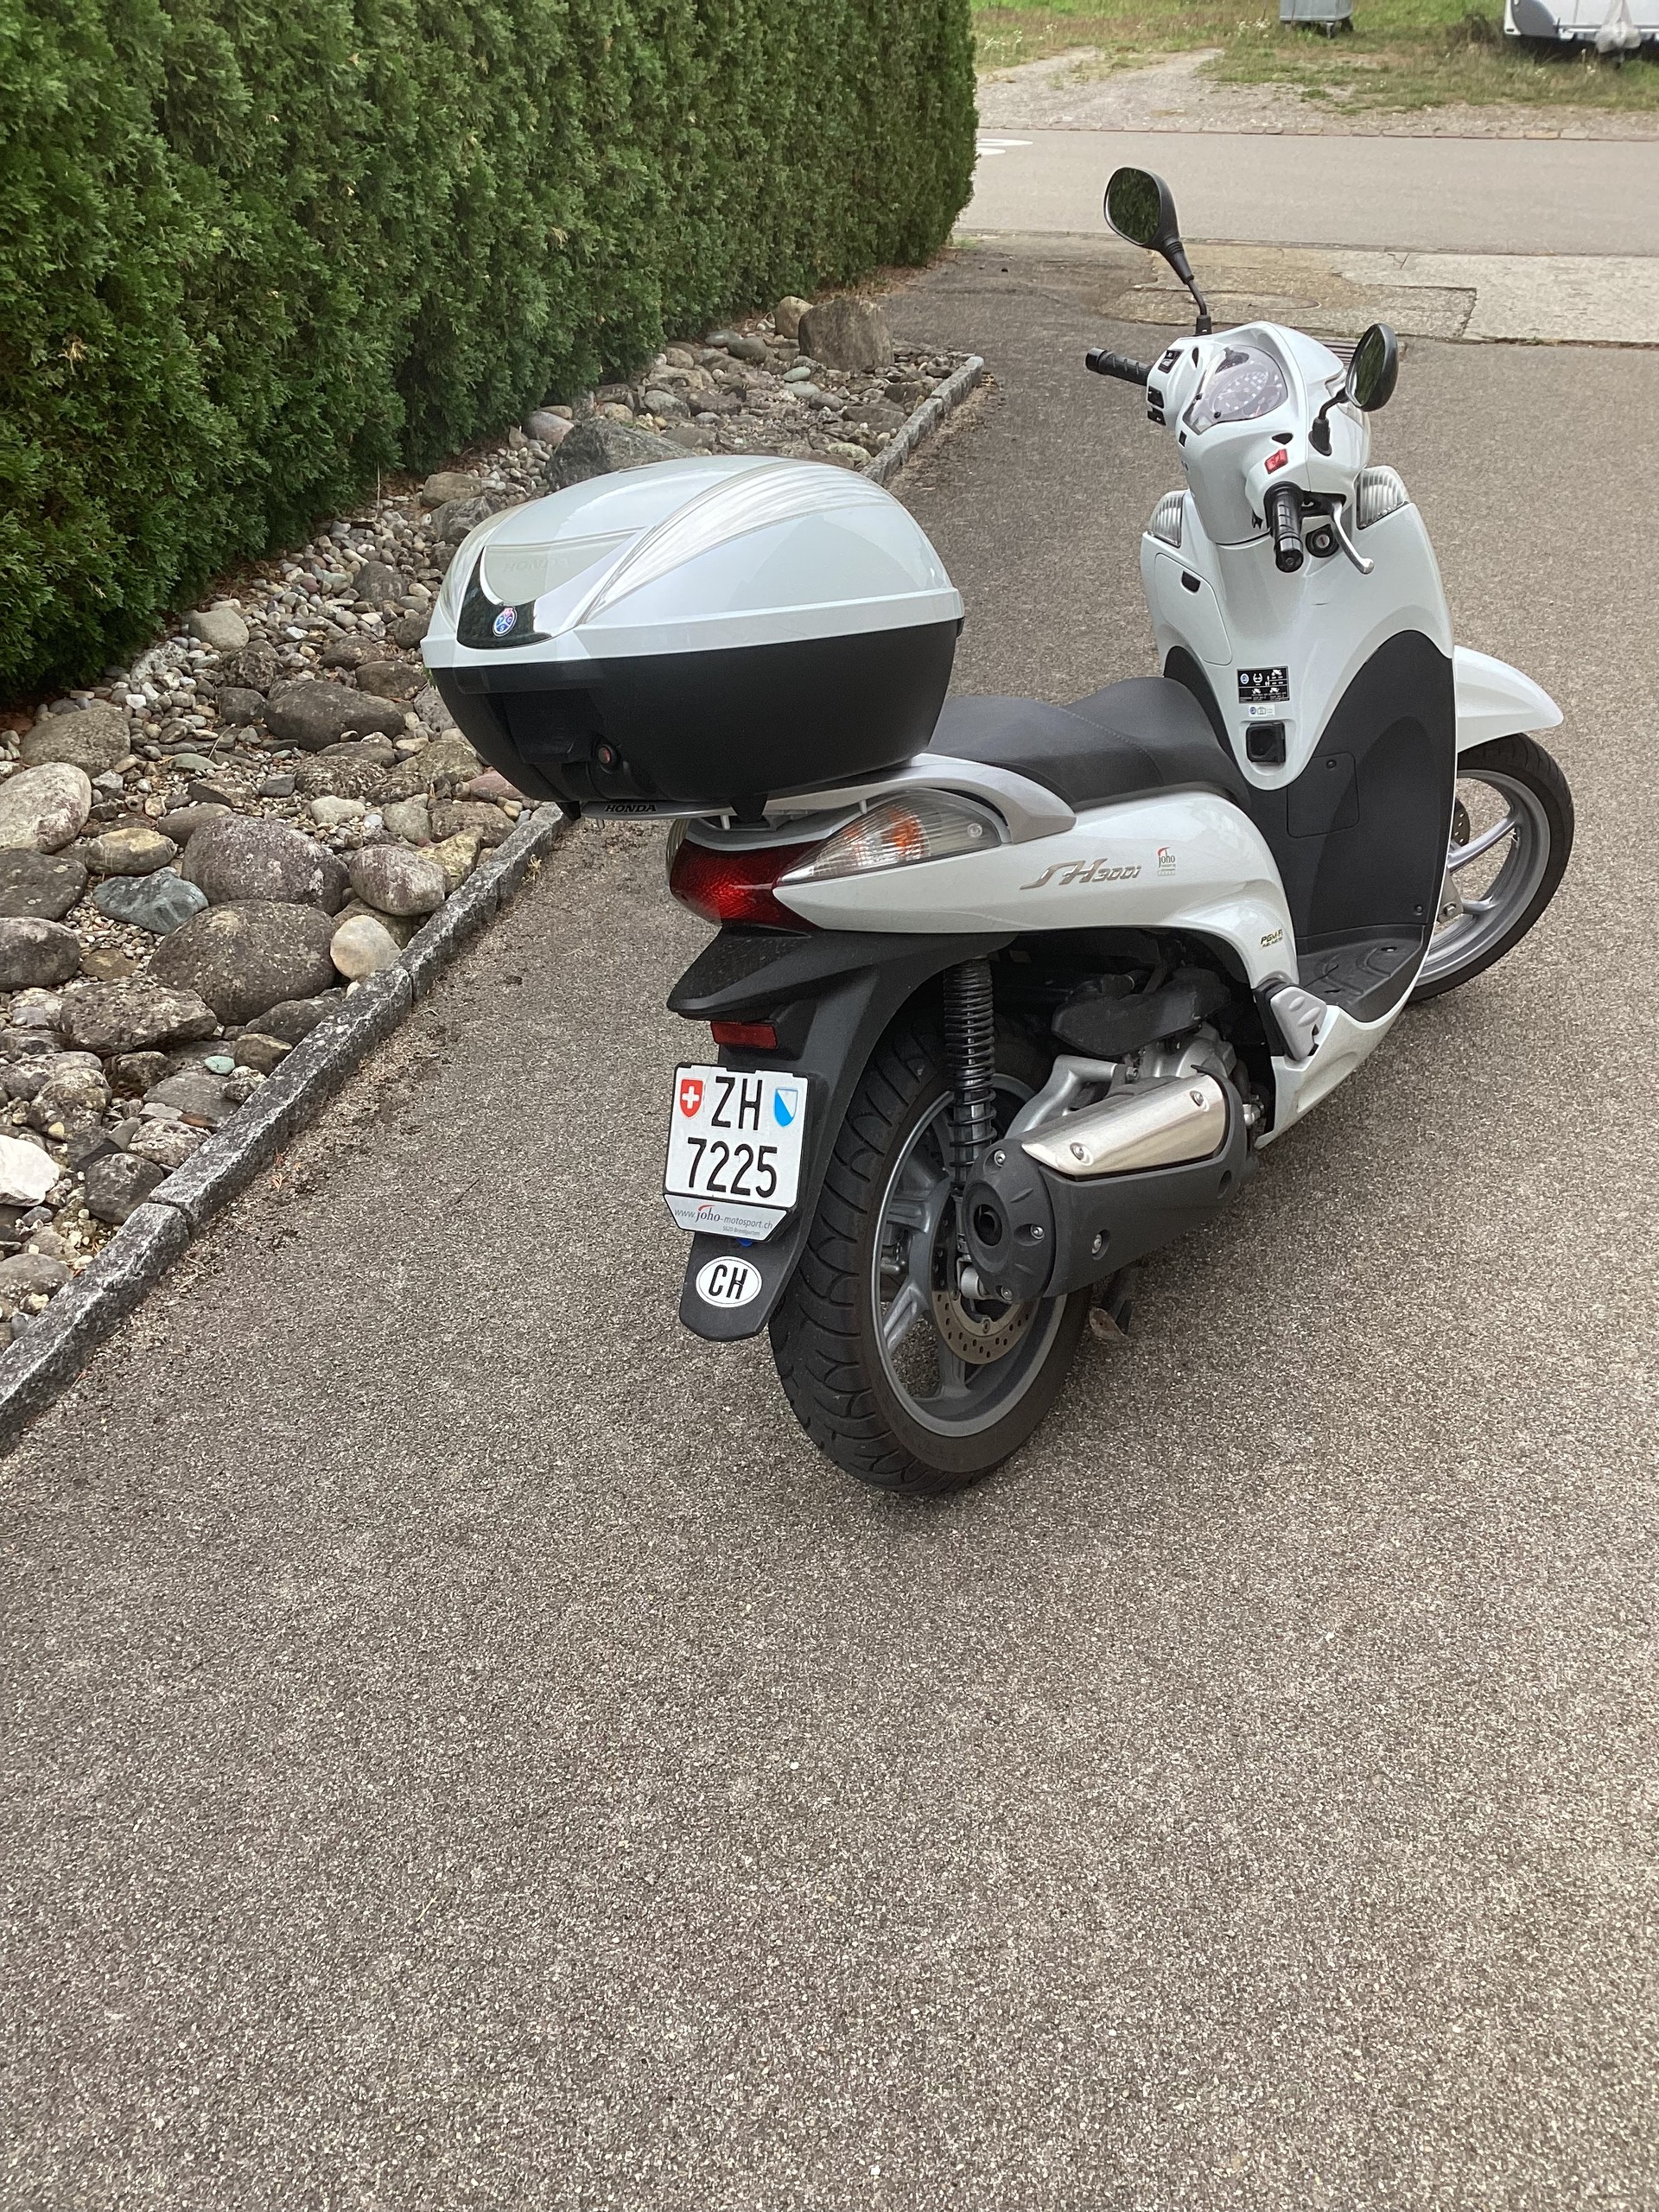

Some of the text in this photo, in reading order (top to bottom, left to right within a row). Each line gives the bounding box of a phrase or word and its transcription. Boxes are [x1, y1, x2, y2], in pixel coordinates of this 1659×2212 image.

[604, 804, 657, 812] HONDA
[711, 1076, 762, 1130] ZH
[688, 1136, 777, 1198] 7225
[674, 1205, 773, 1230] www.joho-motosport.ch
[708, 1264, 748, 1300] CH
